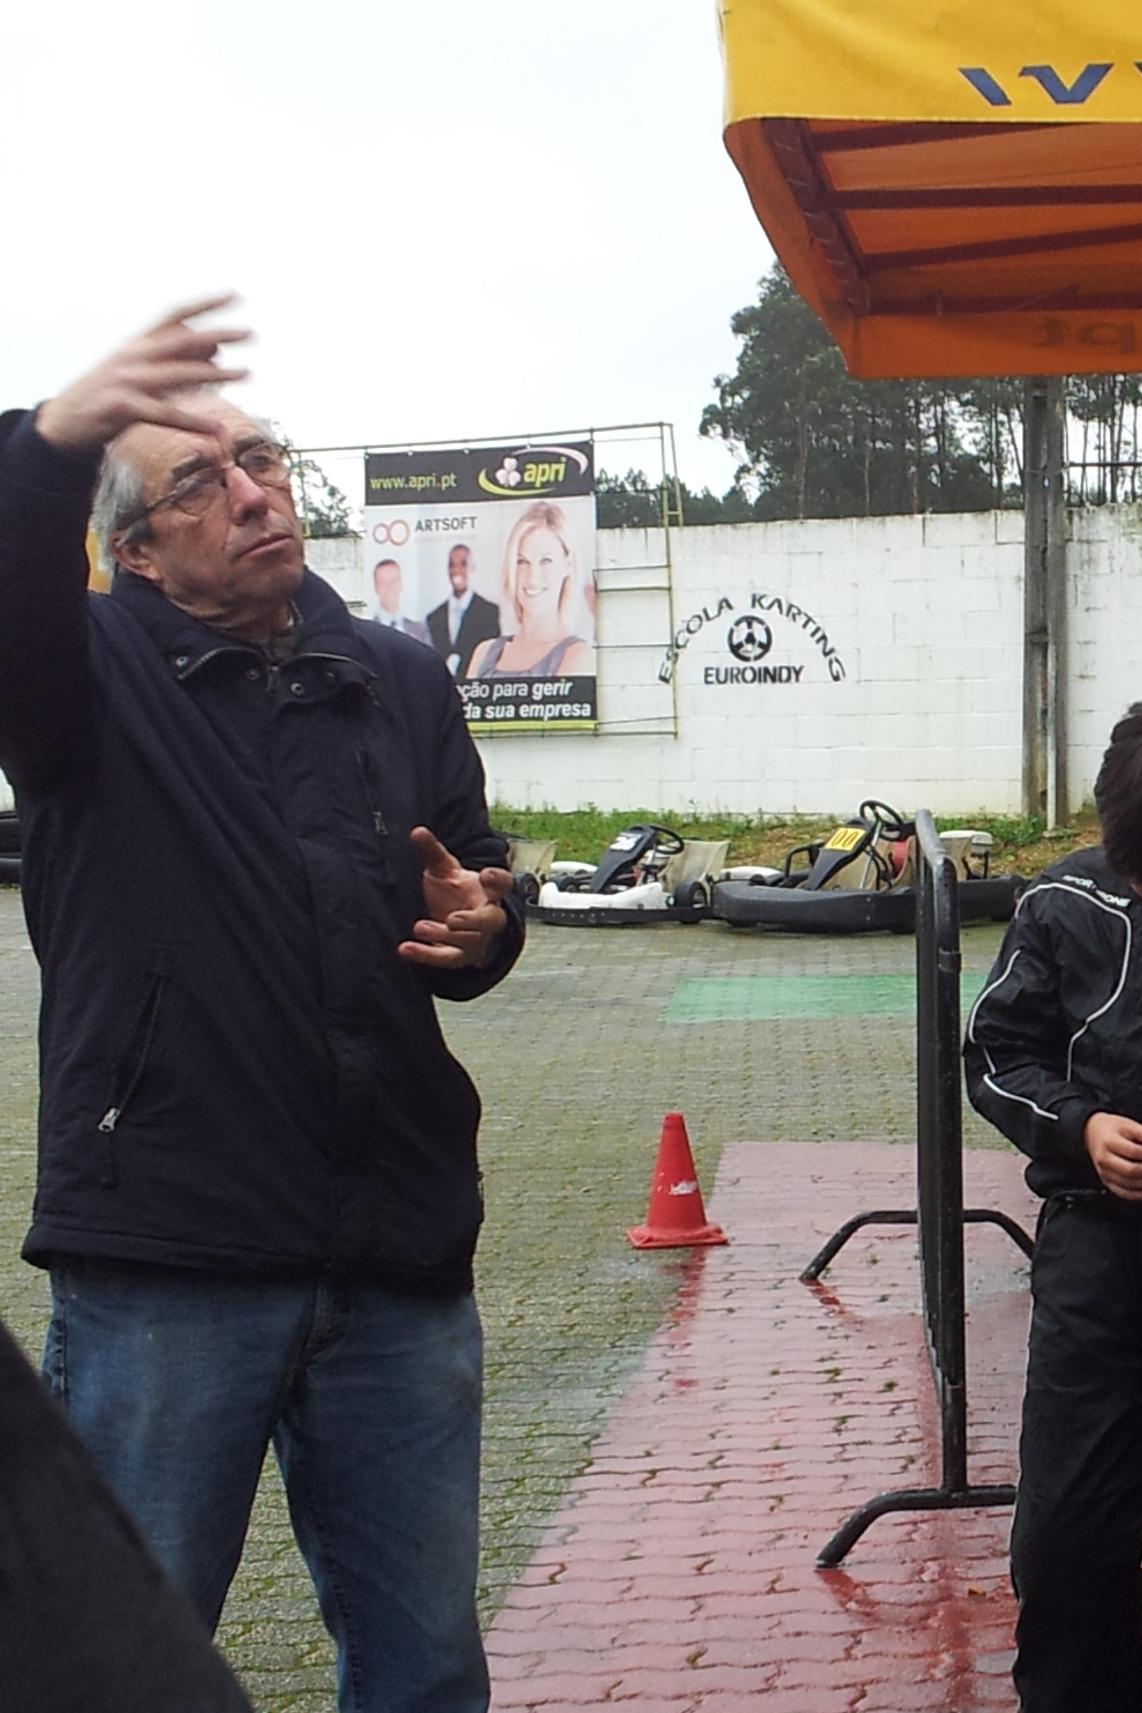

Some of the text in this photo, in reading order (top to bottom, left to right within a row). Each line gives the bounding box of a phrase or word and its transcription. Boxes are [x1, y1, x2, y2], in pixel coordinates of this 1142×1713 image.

[370, 472, 457, 490] www.apri.pt
[523, 457, 567, 488] apri
[415, 516, 477, 531] ARTSOFT
[658, 593, 846, 685] ESCOLA KARTING
[704, 665, 804, 685] EUROINDY
[493, 683, 529, 701] para
[532, 679, 573, 700] gerir
[485, 704, 515, 719] sua
[519, 703, 592, 721] empresa
